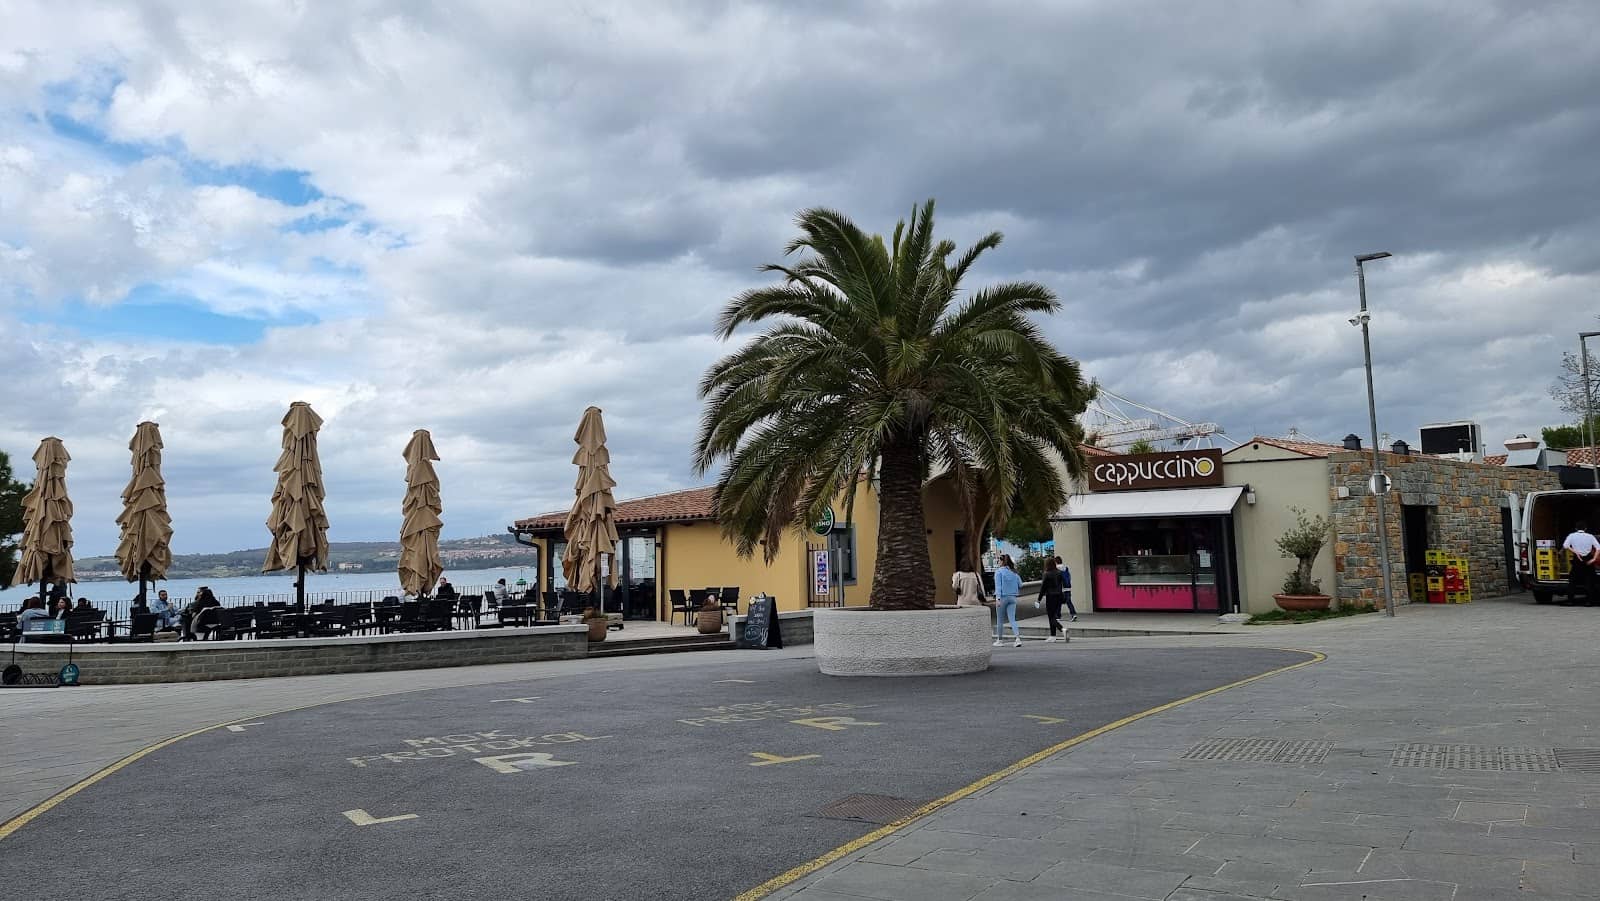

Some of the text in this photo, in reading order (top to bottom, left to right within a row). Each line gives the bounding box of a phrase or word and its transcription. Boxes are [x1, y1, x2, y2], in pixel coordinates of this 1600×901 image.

[1094, 455, 1215, 486] cappuccino
[789, 716, 884, 731] R
[402, 730, 518, 747] MOK
[346, 732, 614, 768] PROTOKOL
[472, 752, 580, 774] R
